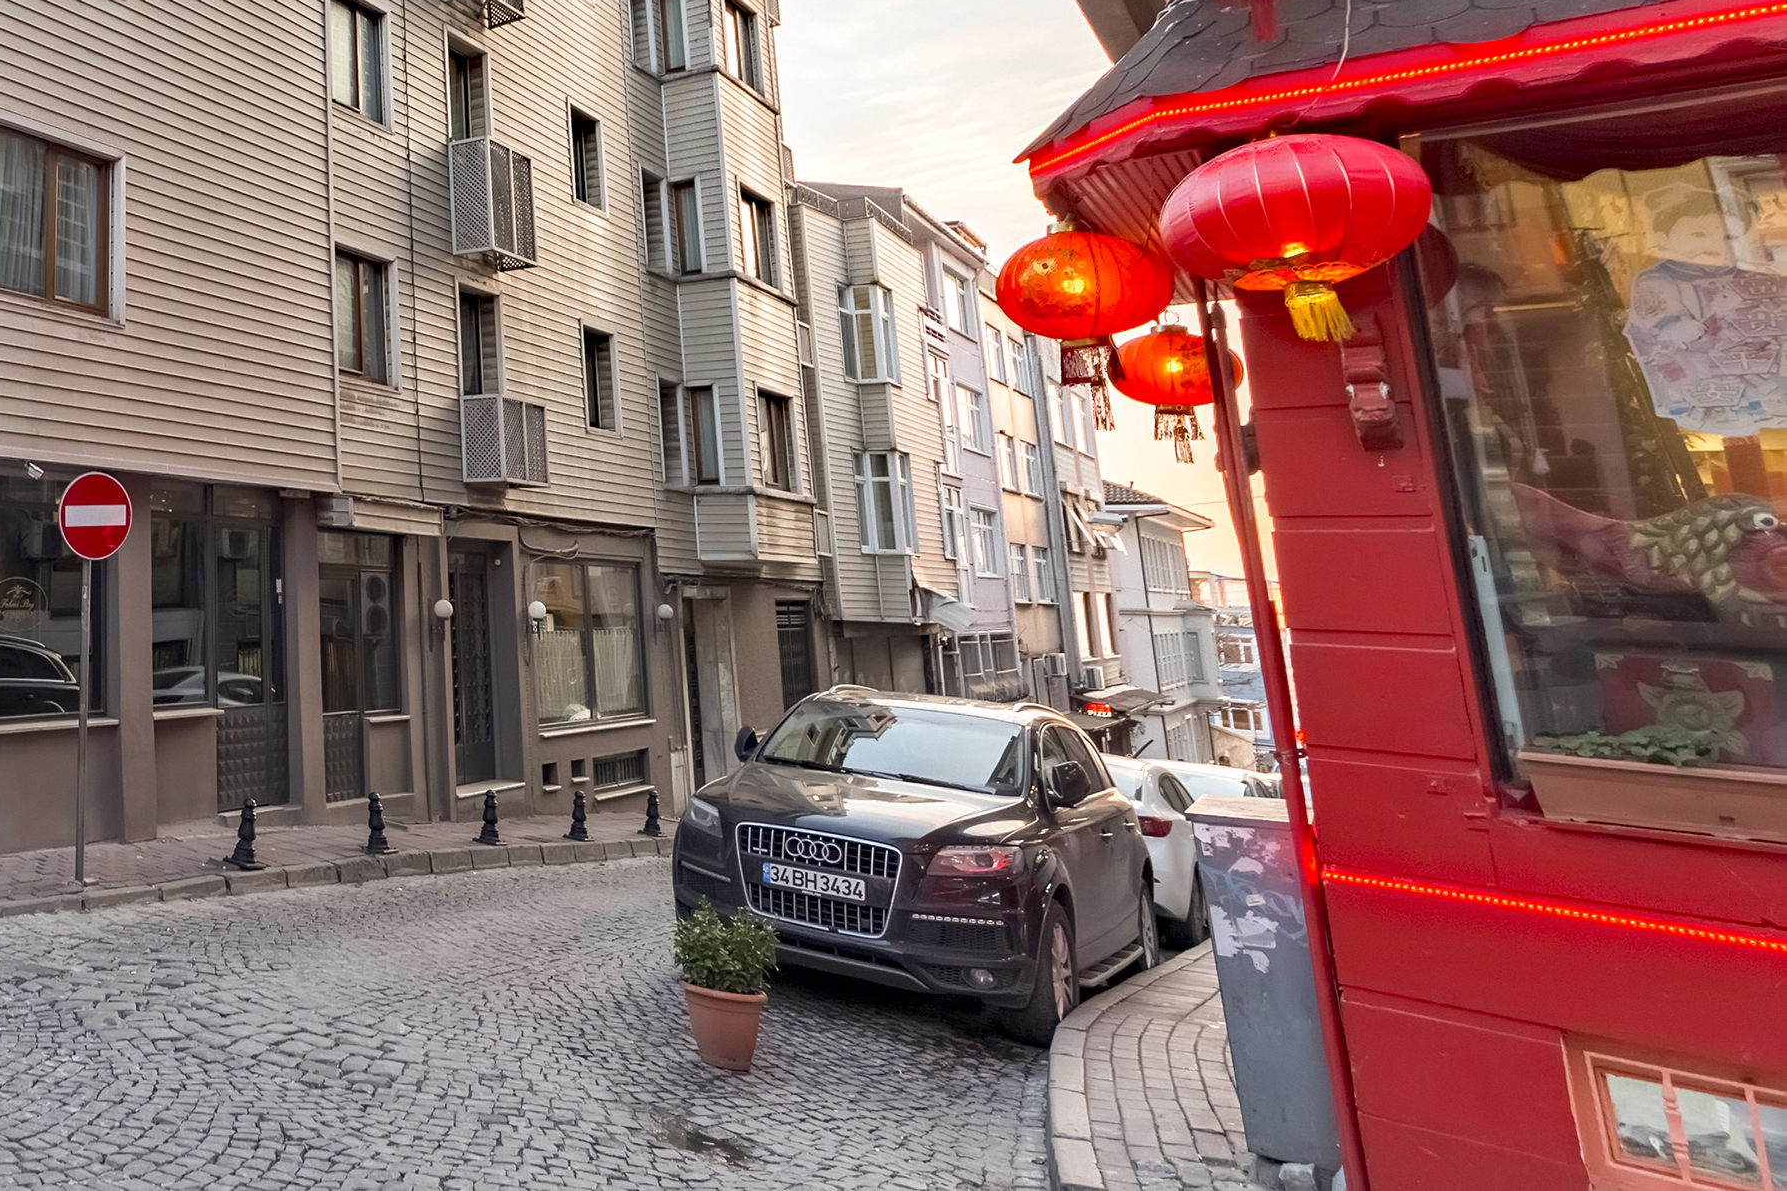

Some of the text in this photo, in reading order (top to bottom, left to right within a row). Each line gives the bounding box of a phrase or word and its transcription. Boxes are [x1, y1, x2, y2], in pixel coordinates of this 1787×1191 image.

[770, 866, 789, 884] 34
[792, 869, 817, 890] BH
[819, 875, 863, 898] 3434
